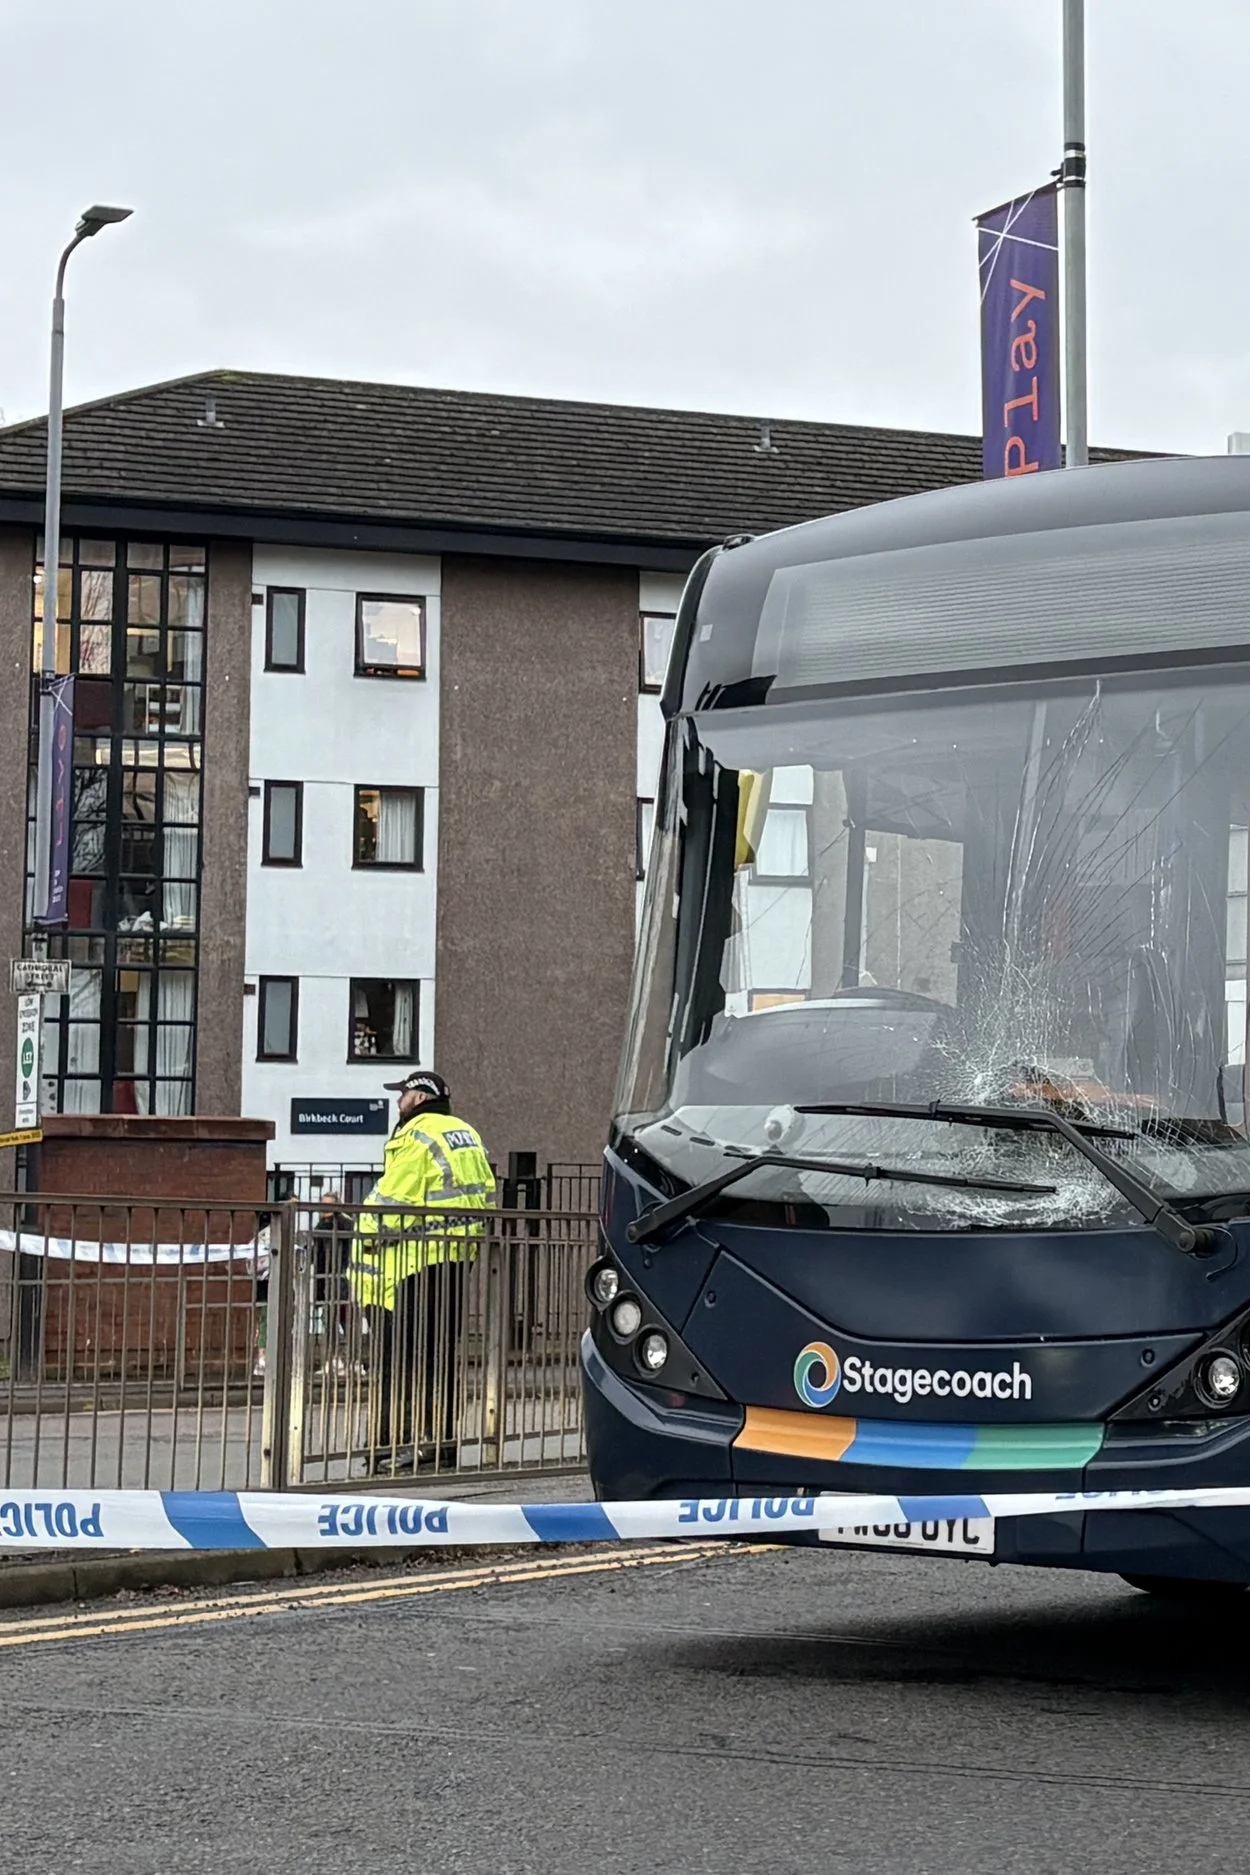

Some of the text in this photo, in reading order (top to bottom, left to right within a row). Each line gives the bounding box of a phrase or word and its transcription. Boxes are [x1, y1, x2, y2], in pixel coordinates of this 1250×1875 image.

[1003, 278, 1047, 478] Play
[339, 1114, 364, 1123] Court
[842, 1356, 1032, 1404] Stagecoach
[0, 1502, 104, 1538] POLIC
[317, 1503, 449, 1538] POLICE
[678, 1498, 816, 1523] POLICE
